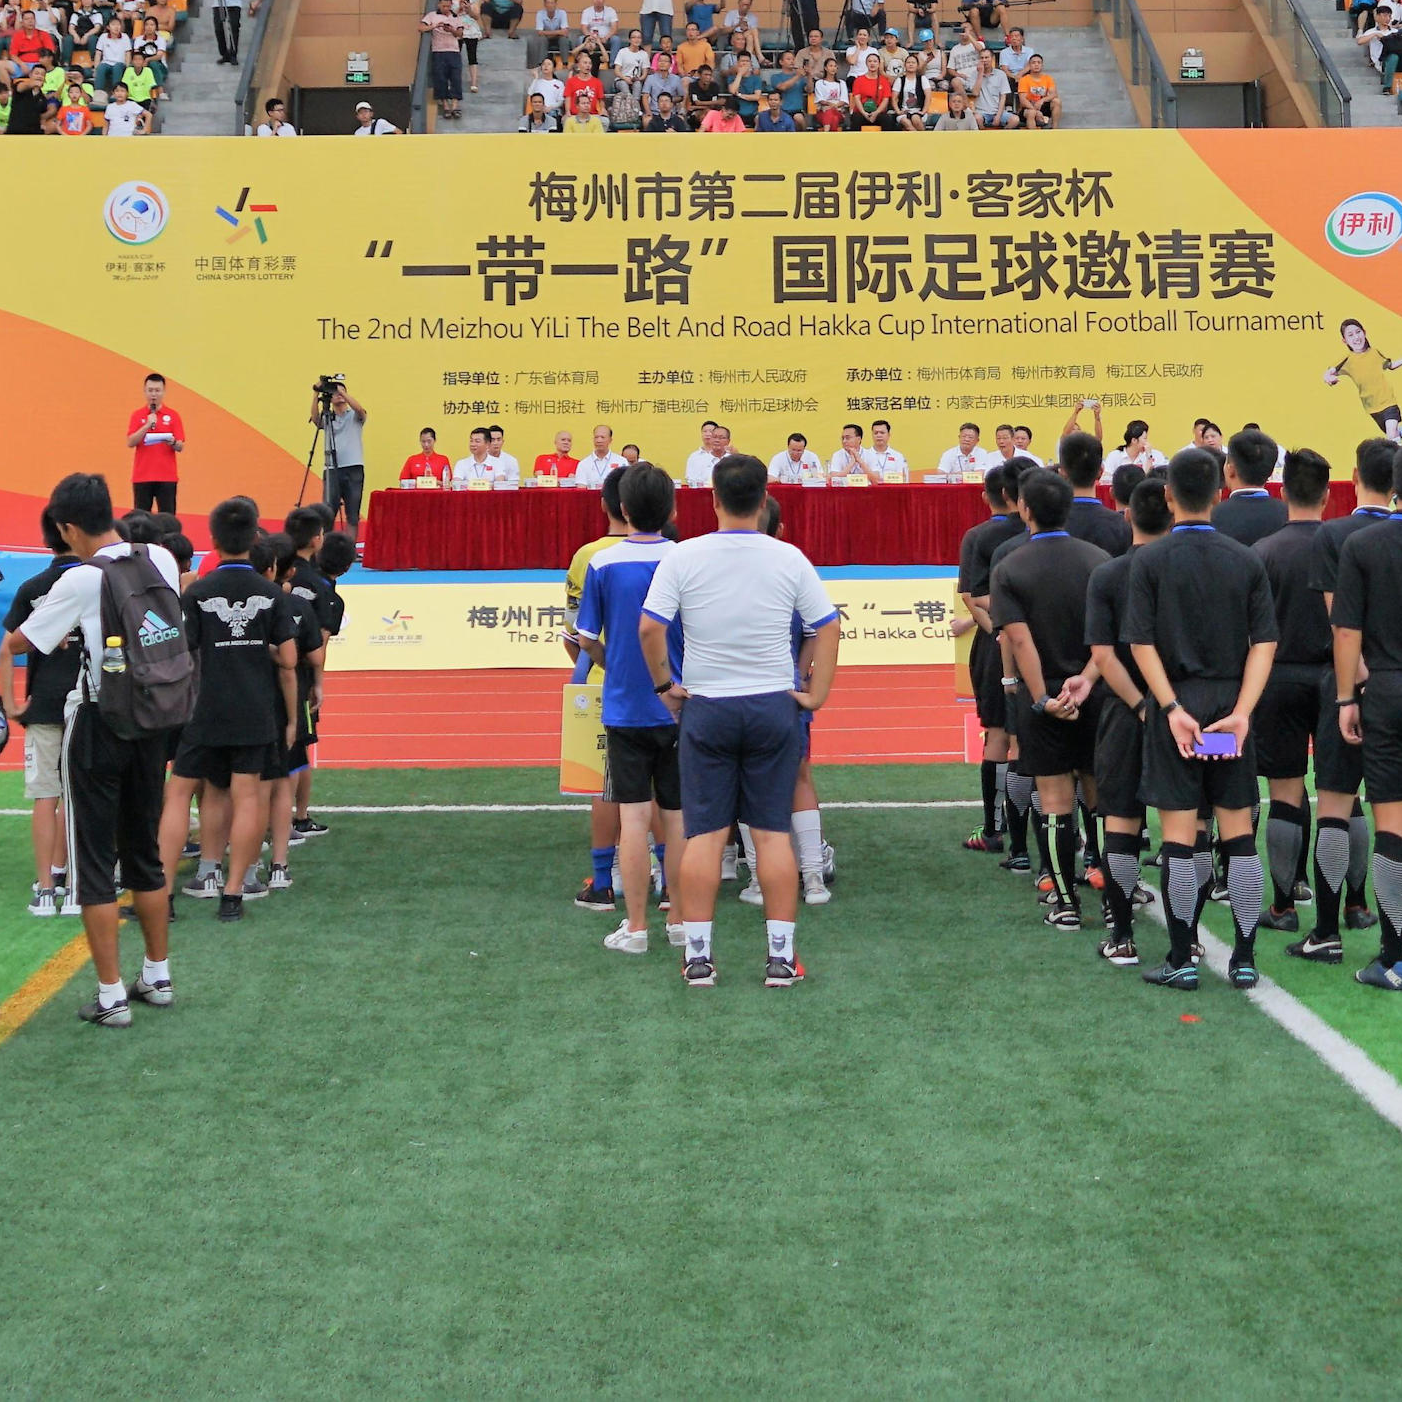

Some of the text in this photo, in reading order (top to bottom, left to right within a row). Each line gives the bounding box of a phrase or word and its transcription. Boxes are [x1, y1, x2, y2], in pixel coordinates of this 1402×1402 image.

[528, 168, 1115, 223] 梅州市第二届伊利·客家杯
[1338, 211, 1395, 237] 伊利
[195, 255, 297, 272] 中国体育彩票
[196, 273, 294, 281] CHINA SPORTS LOTTERY
[316, 309, 1325, 341] The 2nd Meizhou YiLi The Belt And Road Hakka Cup International Football Tournament
[1011, 365, 1096, 380] 梅州市教育局
[1106, 363, 1204, 379] 梅江区人民政府
[596, 399, 710, 415] 梅州市广播电视台
[720, 397, 819, 413] 梅州市足球协会
[506, 630, 539, 643] The
[863, 626, 917, 640] Hakka
